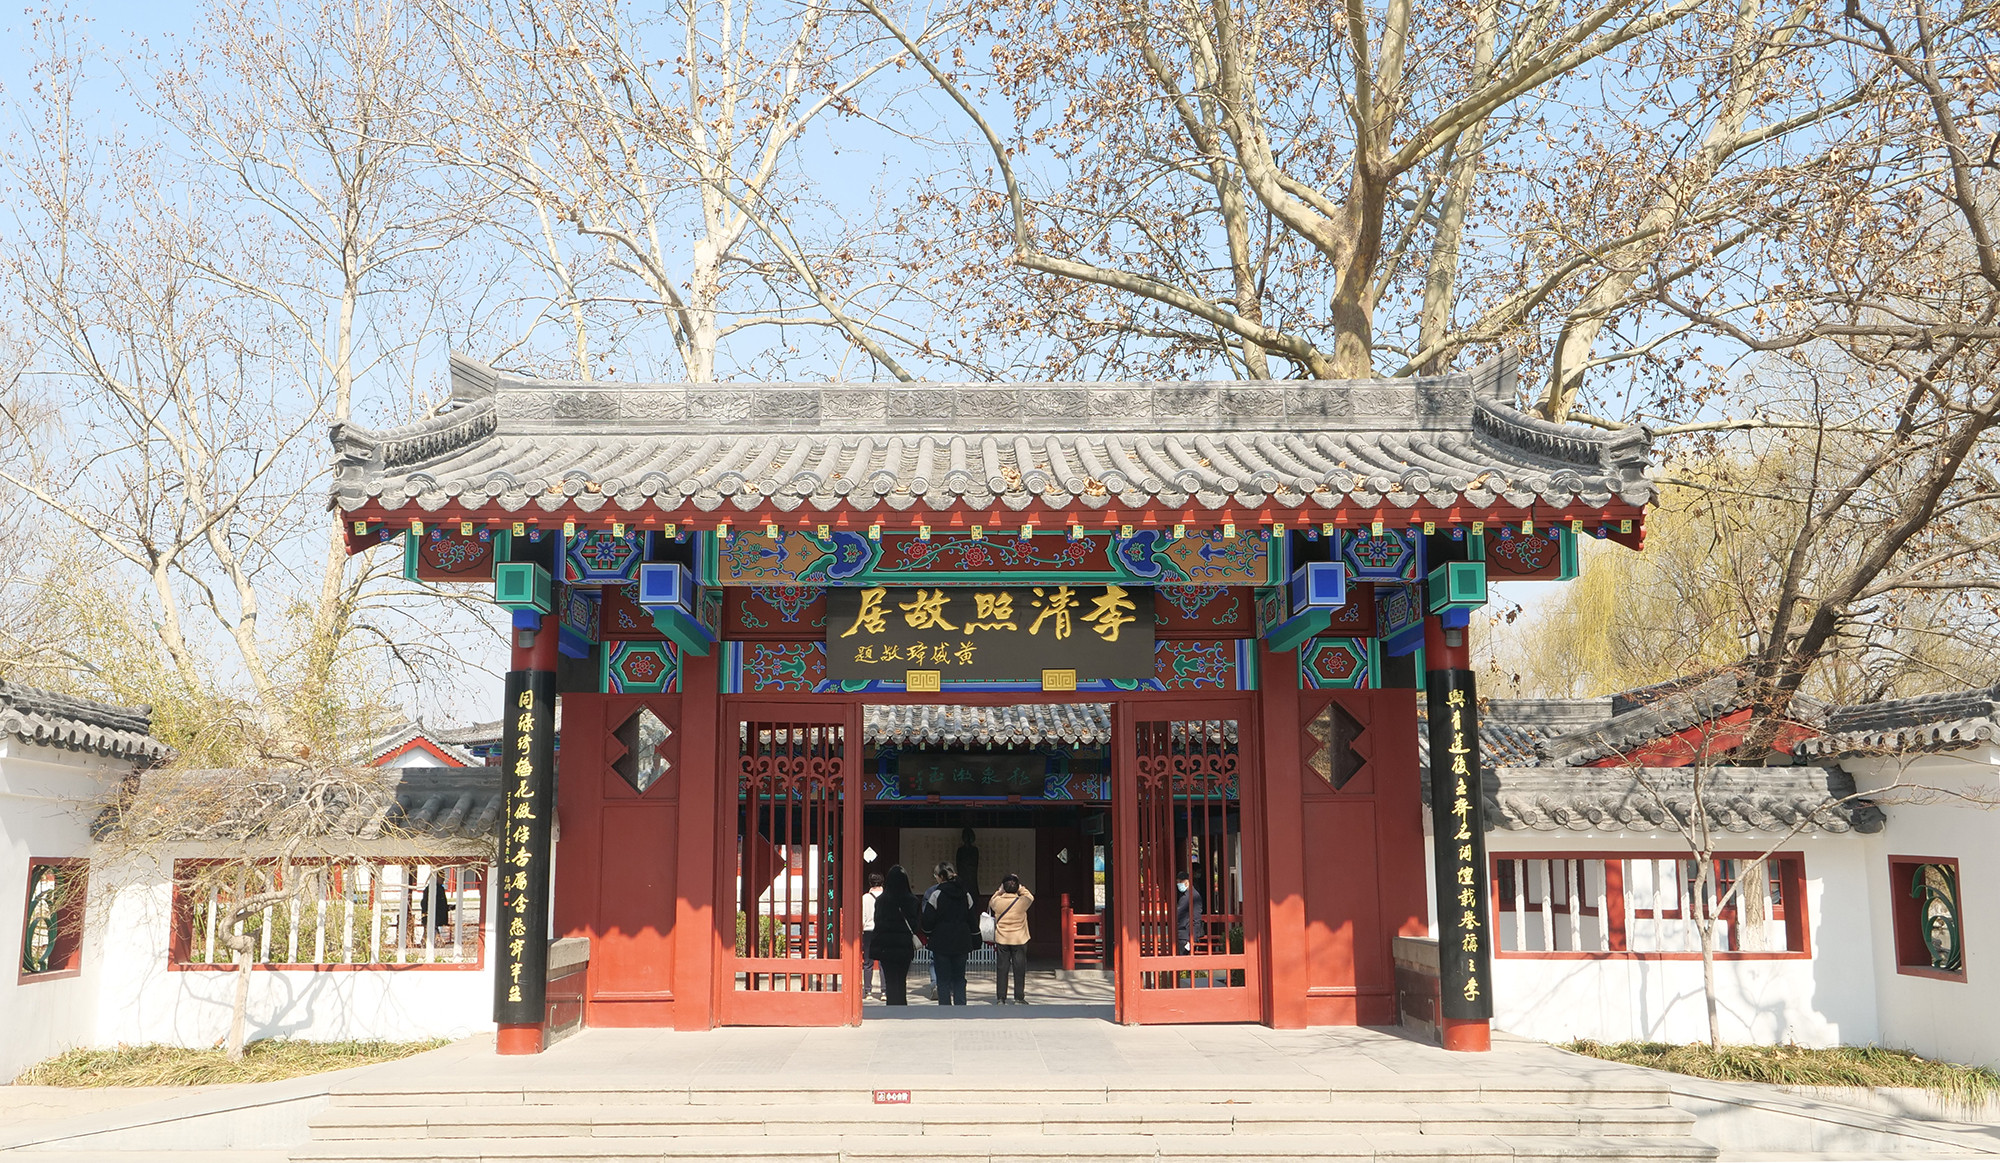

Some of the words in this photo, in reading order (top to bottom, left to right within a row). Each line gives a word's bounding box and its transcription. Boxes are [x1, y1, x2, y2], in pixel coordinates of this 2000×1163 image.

[840, 585, 1137, 642] 李清照故居
